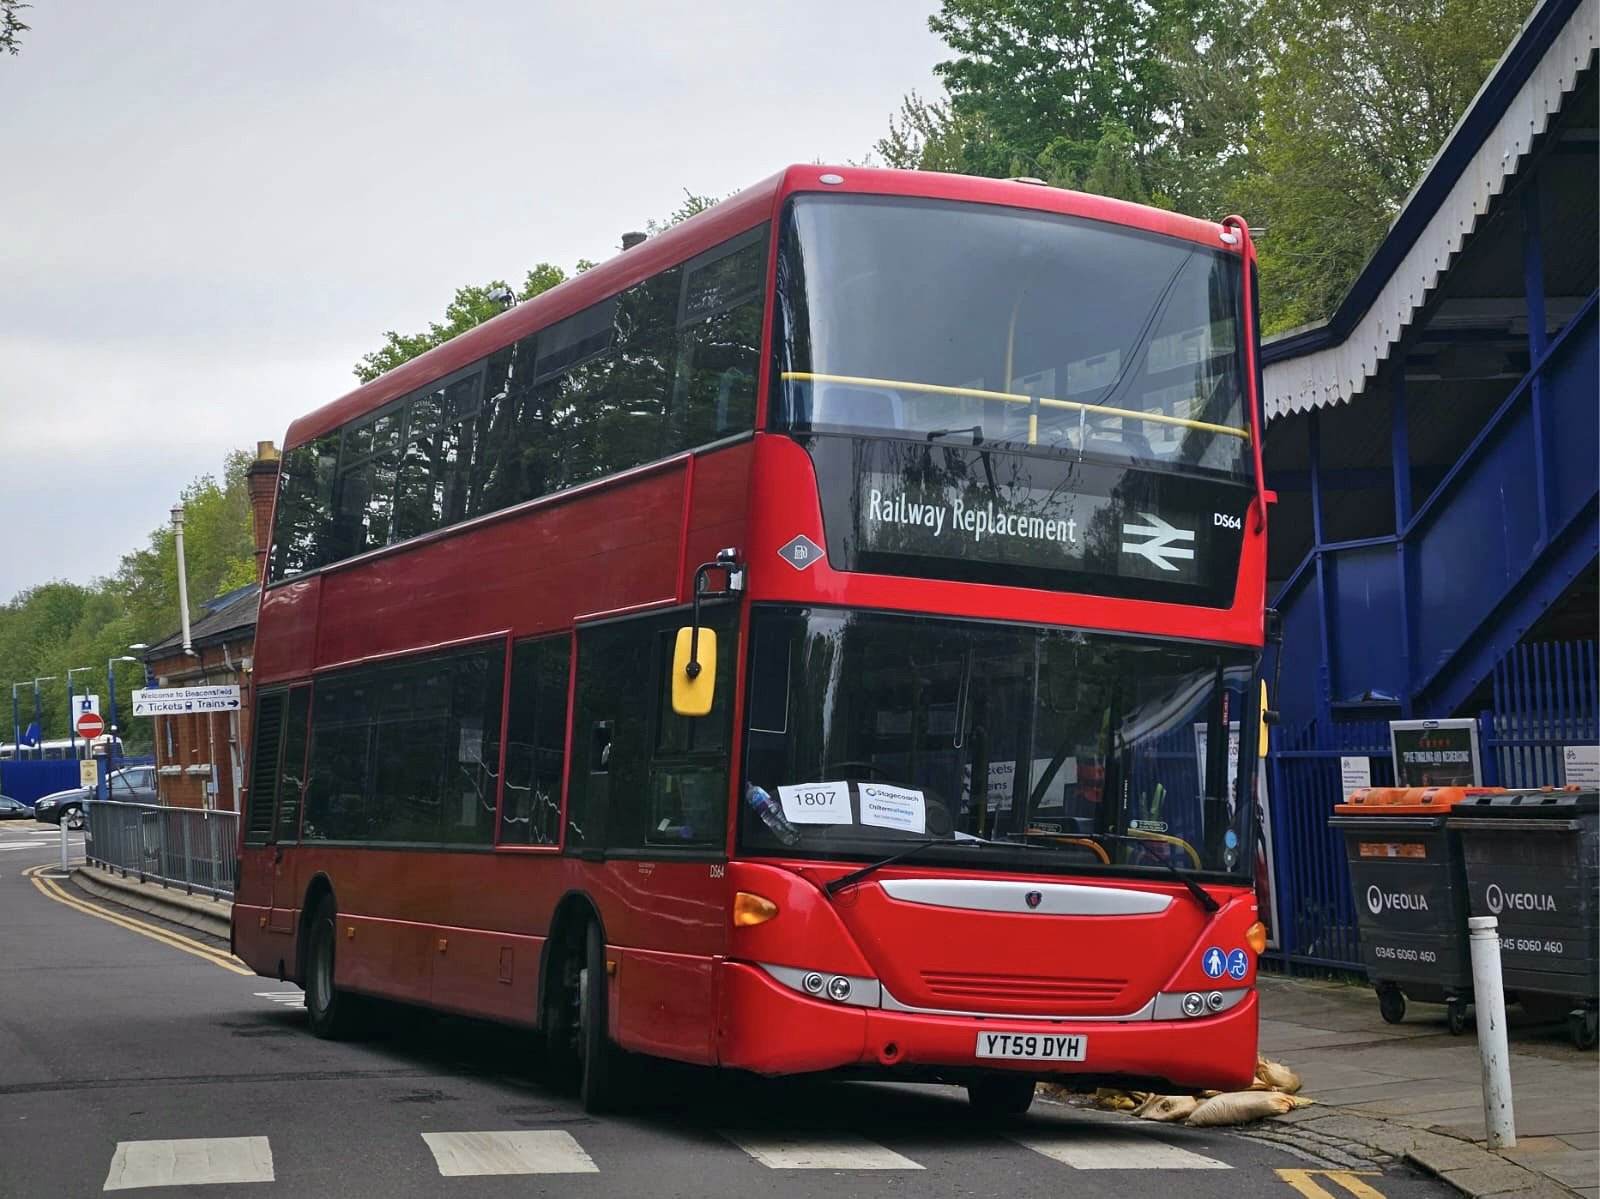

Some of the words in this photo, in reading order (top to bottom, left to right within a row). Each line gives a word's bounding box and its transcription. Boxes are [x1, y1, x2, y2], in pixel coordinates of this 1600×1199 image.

[869, 488, 946, 537] Railway
[952, 498, 1077, 543] Replacement
[1213, 512, 1241, 530] DS64
[141, 692, 174, 700] Welcome
[148, 702, 183, 712] Tickets
[197, 700, 226, 709] Trains
[794, 791, 837, 806] 1807
[876, 789, 919, 803] Stagecoach
[709, 864, 725, 878] DS64
[1384, 893, 1429, 911] VEOLIA
[1504, 893, 1558, 912] VEOLIA
[1375, 946, 1396, 959] 0345
[1396, 948, 1418, 961] 6060
[1420, 951, 1437, 962] 460
[1517, 939, 1542, 952] 6060
[1544, 941, 1563, 954] 460
[986, 1034, 1038, 1056] YT59
[1041, 1037, 1080, 1057] DYH
